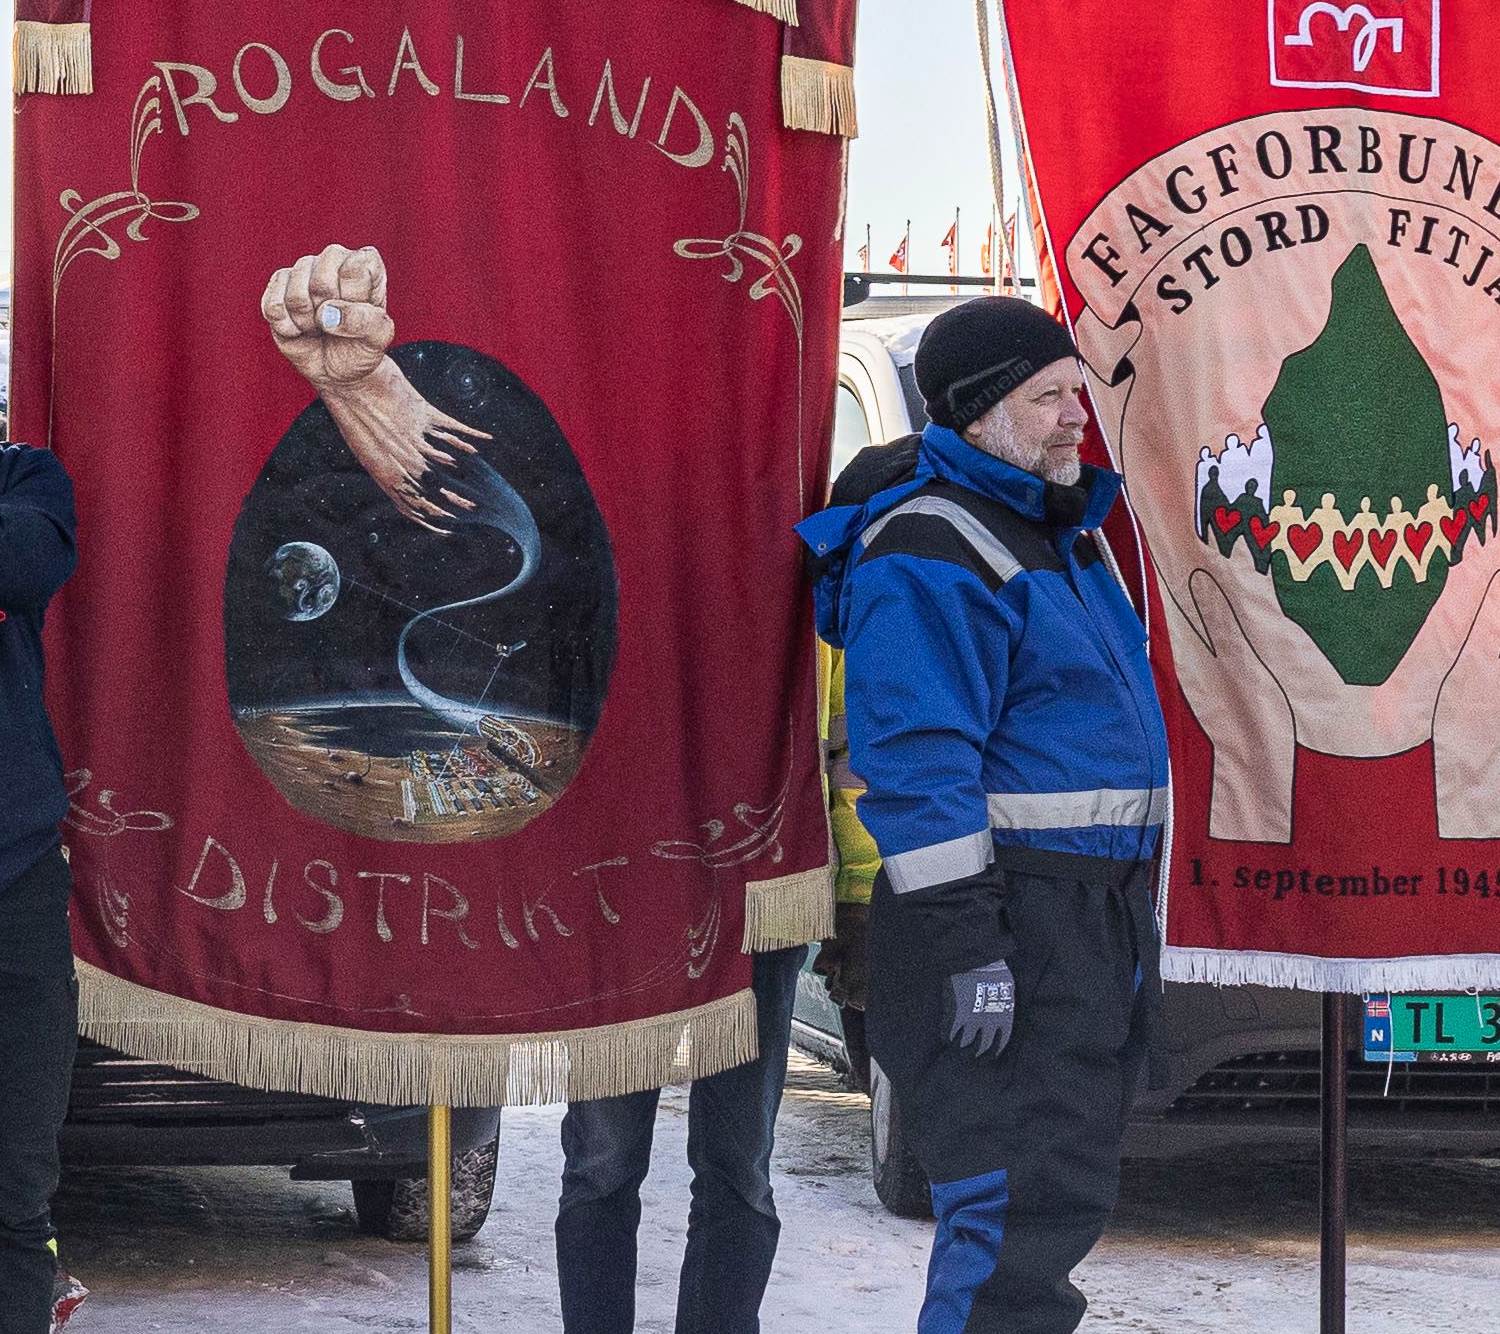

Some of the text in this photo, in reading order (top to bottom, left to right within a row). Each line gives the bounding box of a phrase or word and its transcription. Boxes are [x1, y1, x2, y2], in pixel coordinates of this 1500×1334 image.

[152, 28, 716, 169] ROGALAND
[1156, 203, 1330, 315] STORD
[174, 834, 629, 949] DISTRIKT
[1190, 858, 1220, 888] 1.
[1233, 866, 1423, 900] september
[1405, 1002, 1455, 1044] TL
